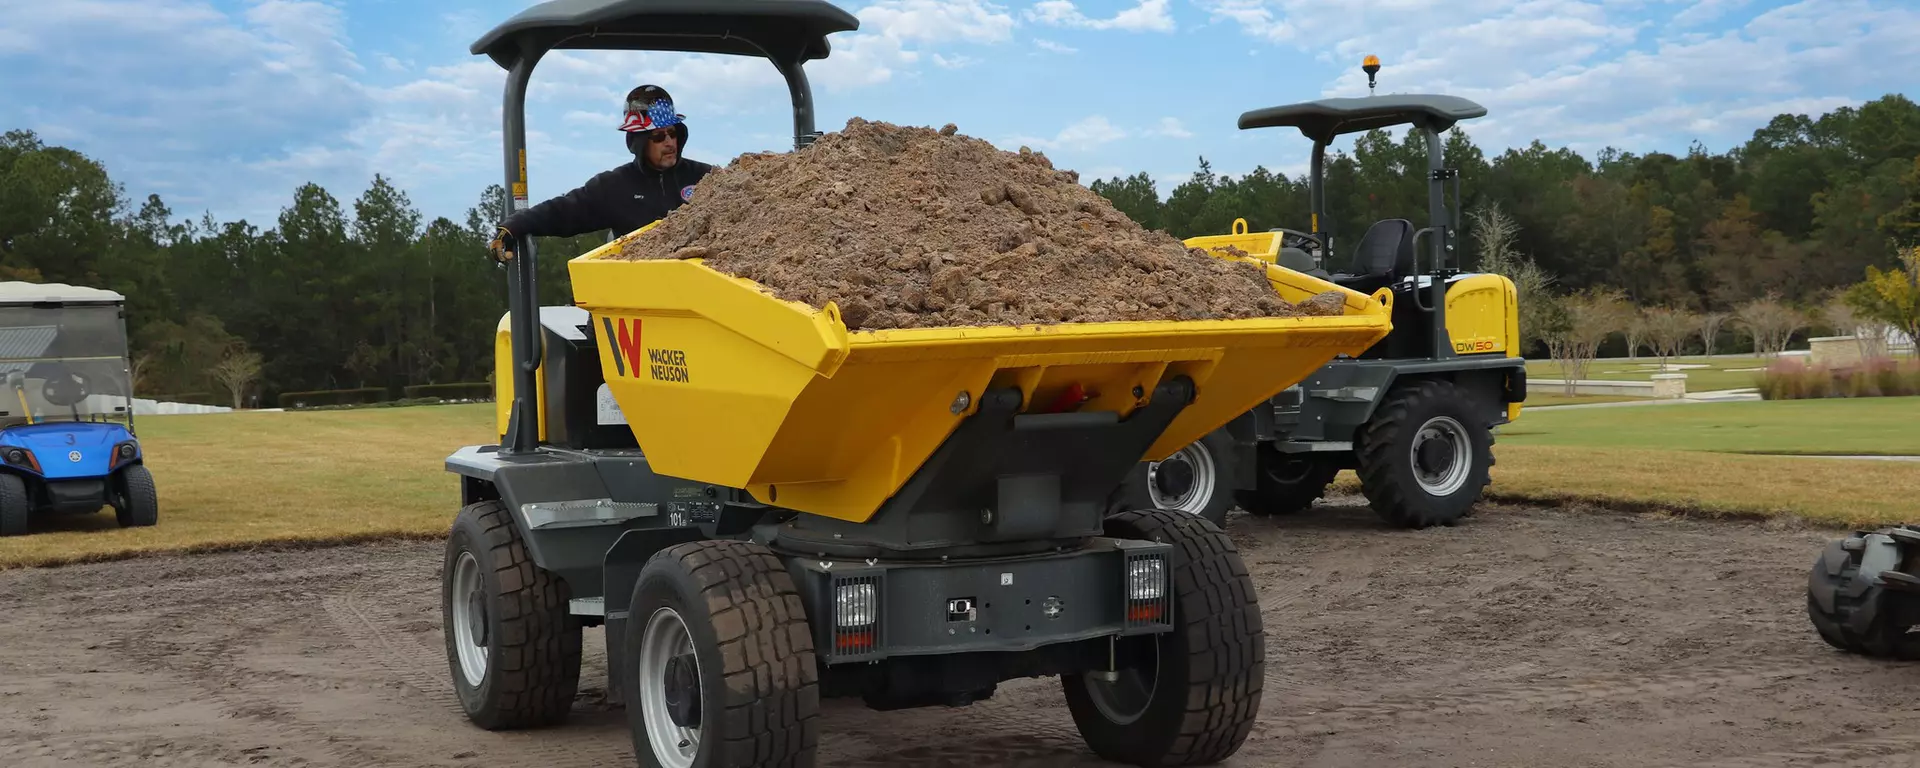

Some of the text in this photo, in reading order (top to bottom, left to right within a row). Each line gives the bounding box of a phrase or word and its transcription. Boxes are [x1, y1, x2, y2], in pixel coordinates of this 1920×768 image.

[647, 348, 687, 366] WACKER
[650, 364, 690, 383] NEUSON
[63, 433, 76, 446] 3
[669, 512, 682, 526] 101
